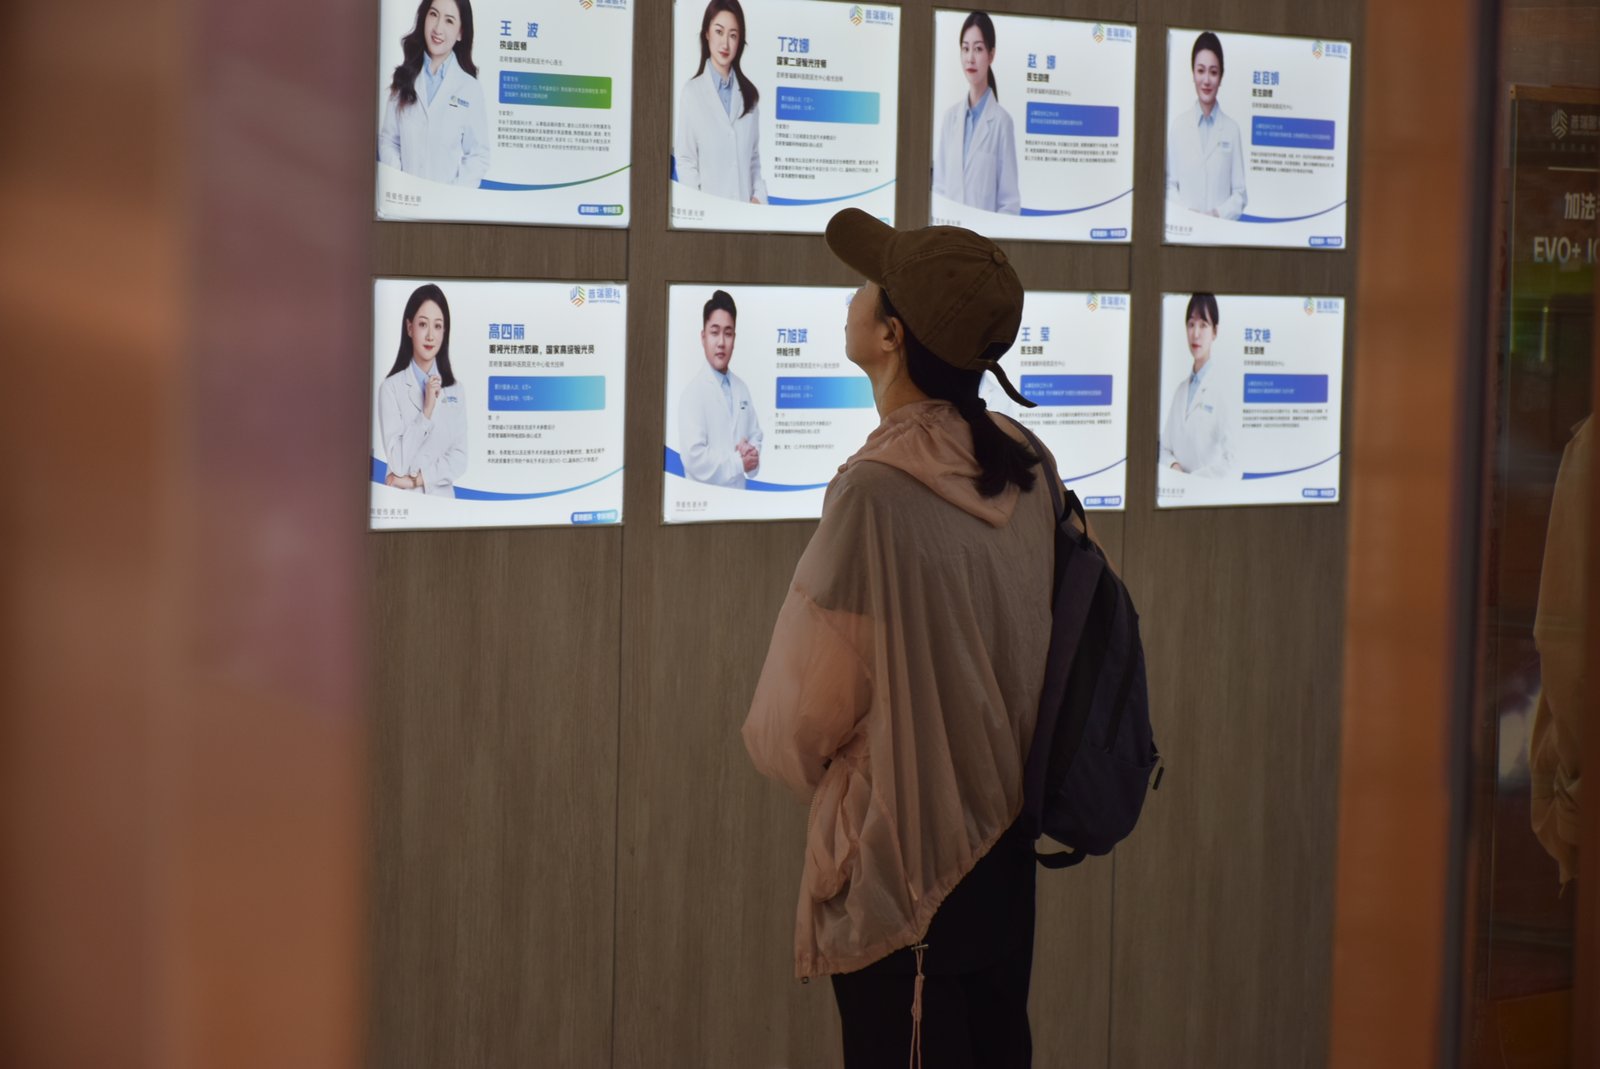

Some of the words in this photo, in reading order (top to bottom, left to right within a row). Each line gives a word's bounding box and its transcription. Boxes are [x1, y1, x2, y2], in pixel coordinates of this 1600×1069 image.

[500, 20, 512, 36] 王
[527, 22, 539, 38] 波
[499, 40, 528, 51] 执业医师
[1571, 115, 1600, 131] 普瑞眼
[1565, 191, 1600, 221] 加法
[1533, 236, 1582, 263] EVO+
[488, 323, 525, 340] 高四丽
[1021, 326, 1031, 342] 王
